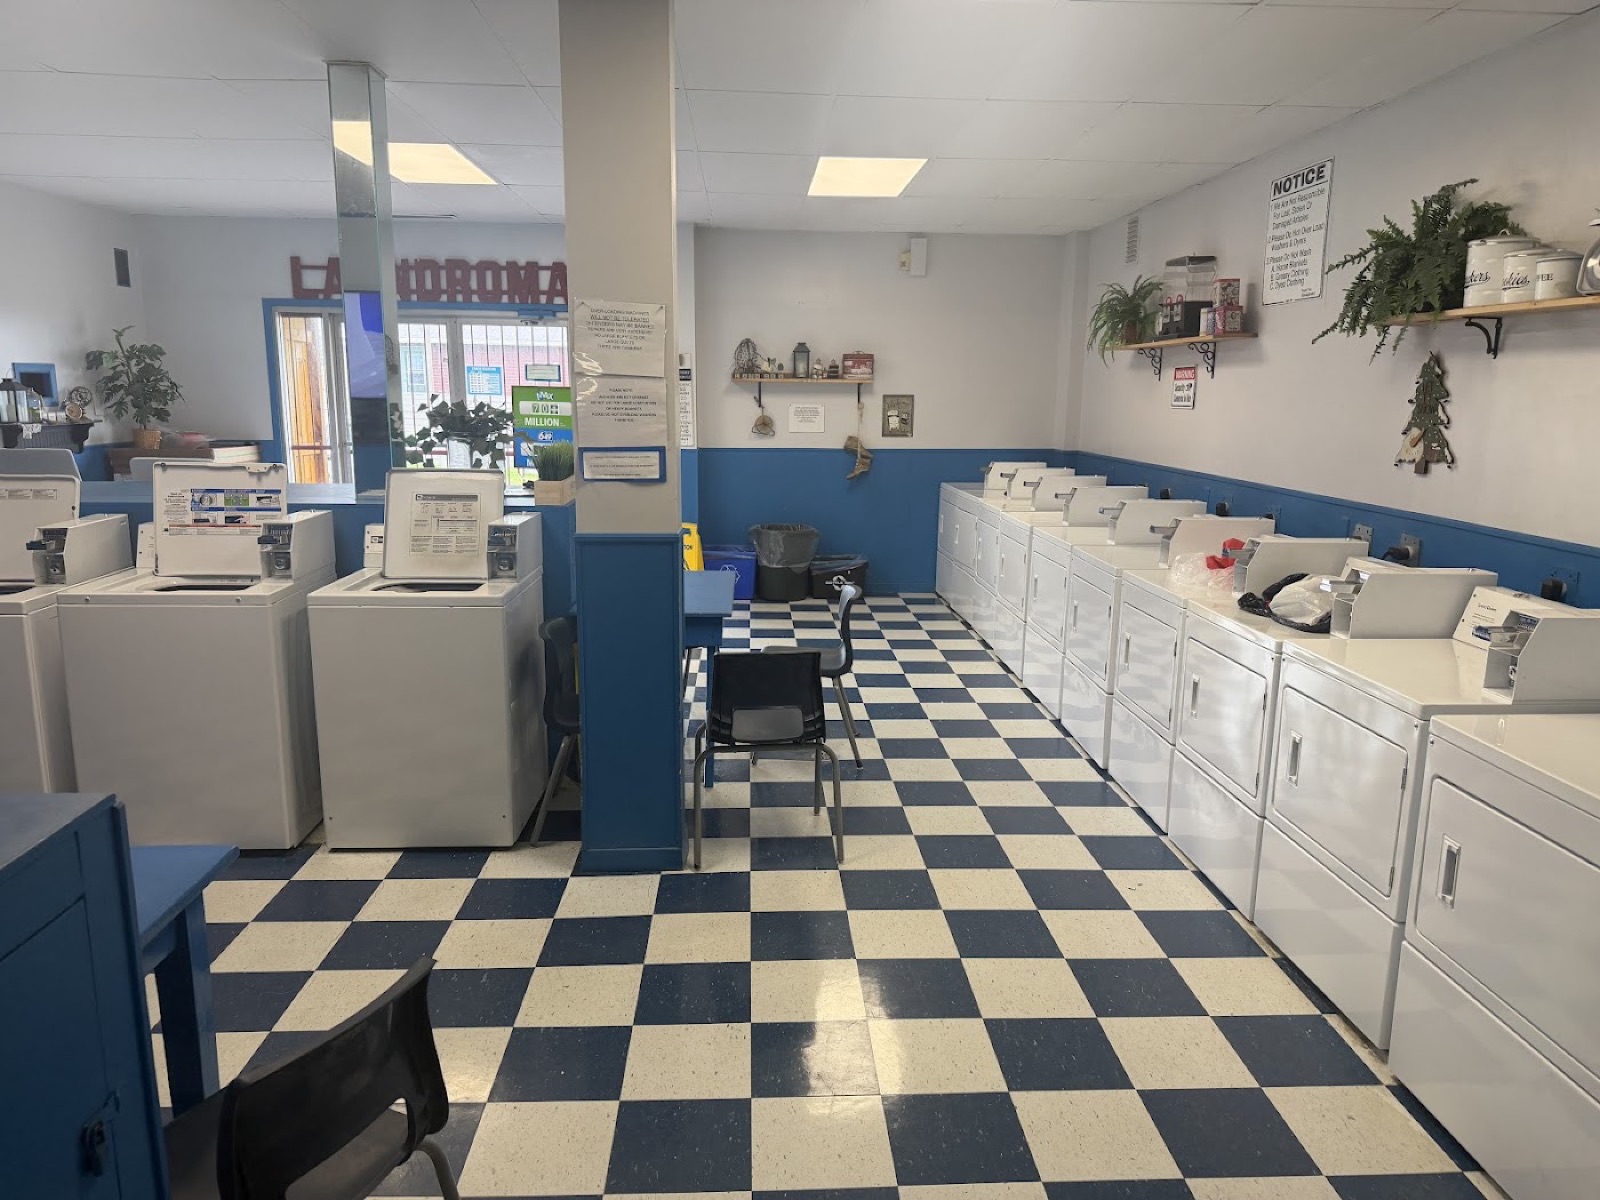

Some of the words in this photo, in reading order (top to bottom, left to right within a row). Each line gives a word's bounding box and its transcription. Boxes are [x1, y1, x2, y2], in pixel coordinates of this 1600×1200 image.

[1273, 163, 1326, 196] NOTICE
[1298, 187, 1325, 201] Responsible
[1273, 219, 1290, 230] Damaged
[1302, 226, 1312, 234] Over
[1312, 222, 1324, 232] Load
[1299, 248, 1312, 257] Wash
[1536, 272, 1553, 282] FEE
[1286, 278, 1304, 288] Clothing
[1175, 369, 1194, 379] WARNING
[524, 417, 560, 427] MILLION
